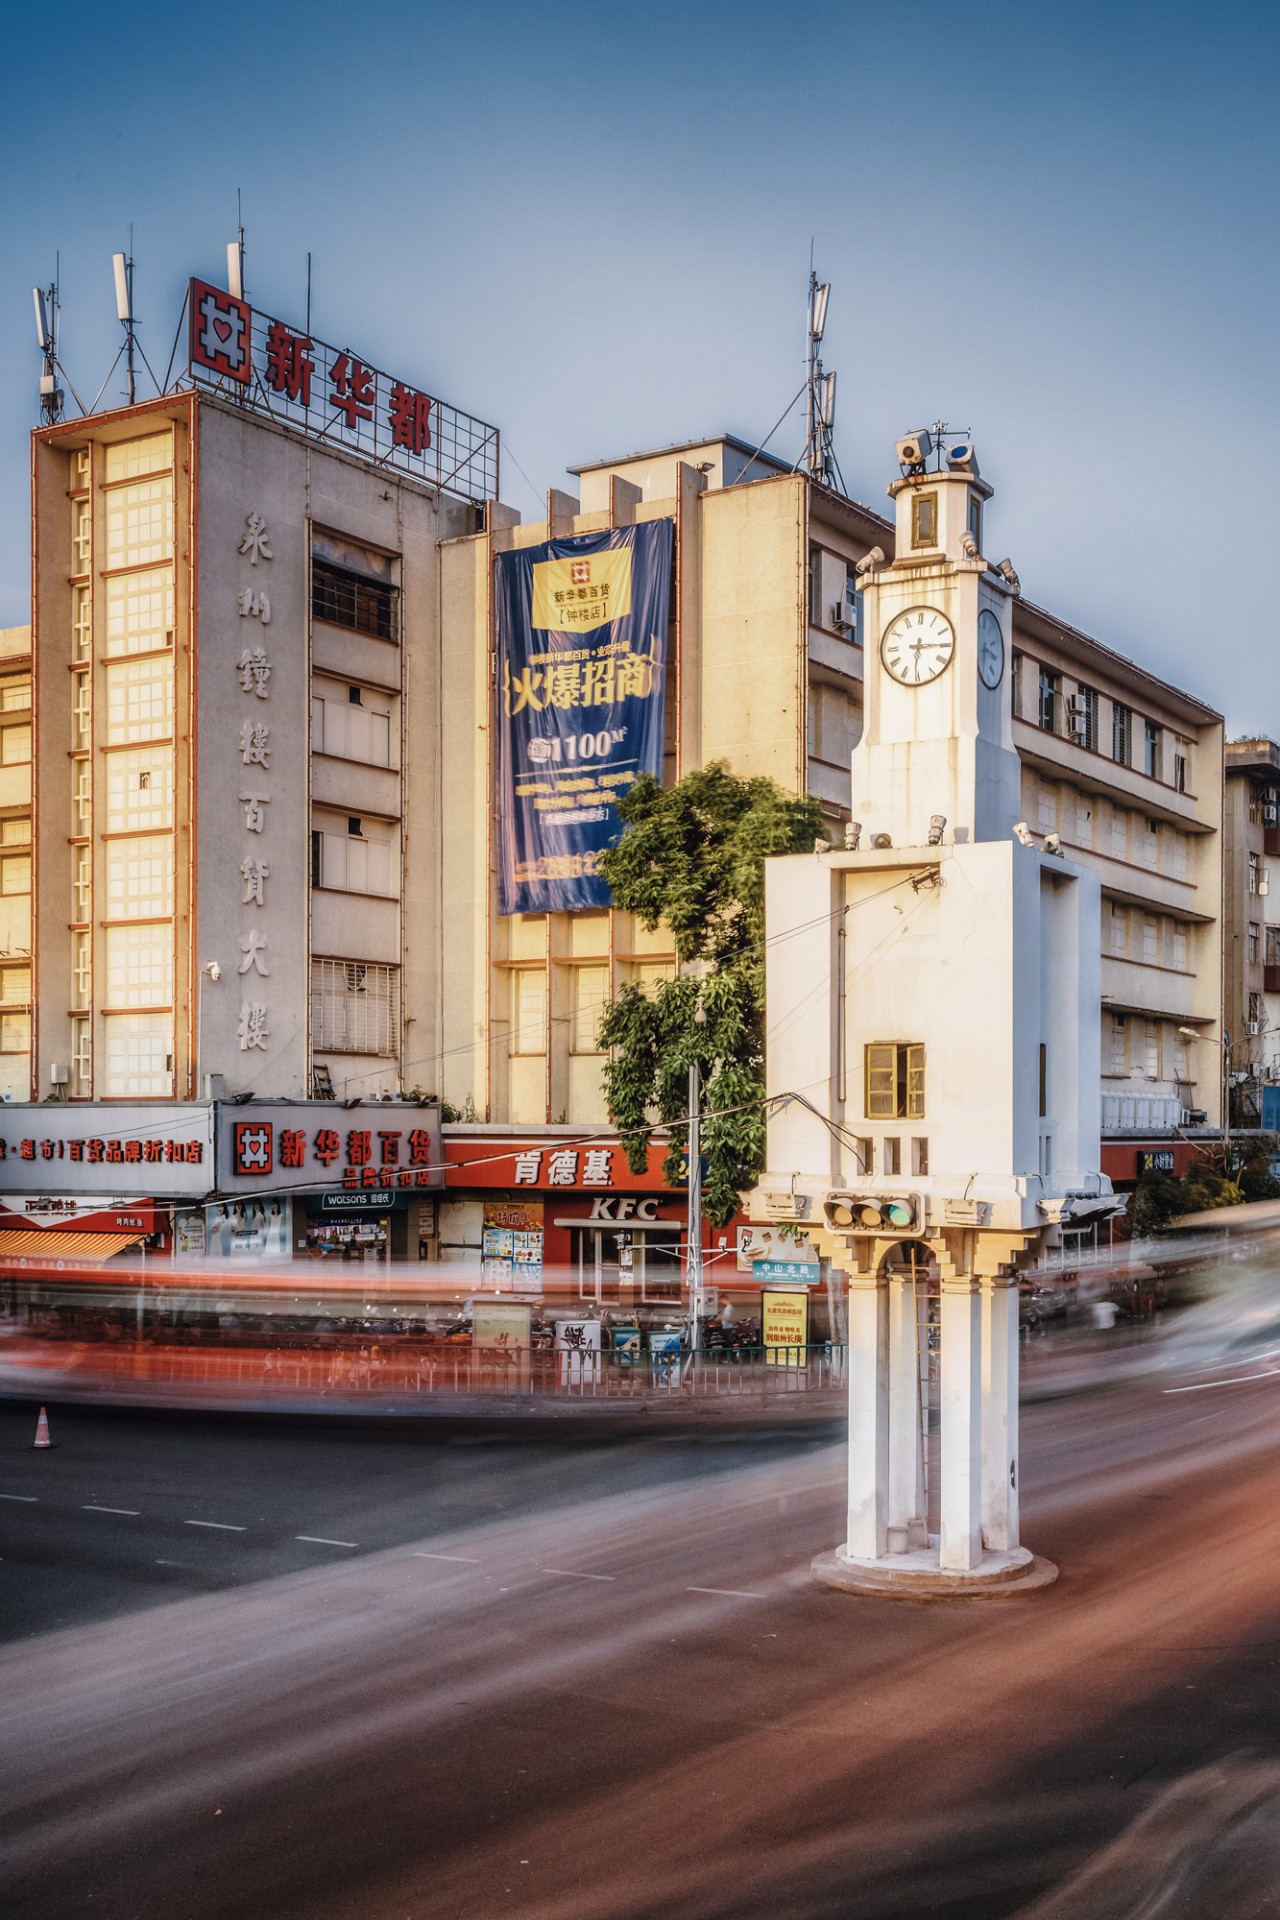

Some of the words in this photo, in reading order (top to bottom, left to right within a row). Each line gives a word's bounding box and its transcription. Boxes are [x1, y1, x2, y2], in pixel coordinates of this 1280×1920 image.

[265, 321, 432, 455] 新华都
[237, 511, 273, 1052] 泉州鐘樓百貨大樓
[280, 1129, 431, 1167] 新华都百货
[343, 1166, 430, 1189] 品牌折扣店
[515, 1150, 613, 1186] 肯德基
[328, 1194, 368, 1206] watsons
[589, 1197, 660, 1221] KFC
[762, 1263, 809, 1274] 中山北路
